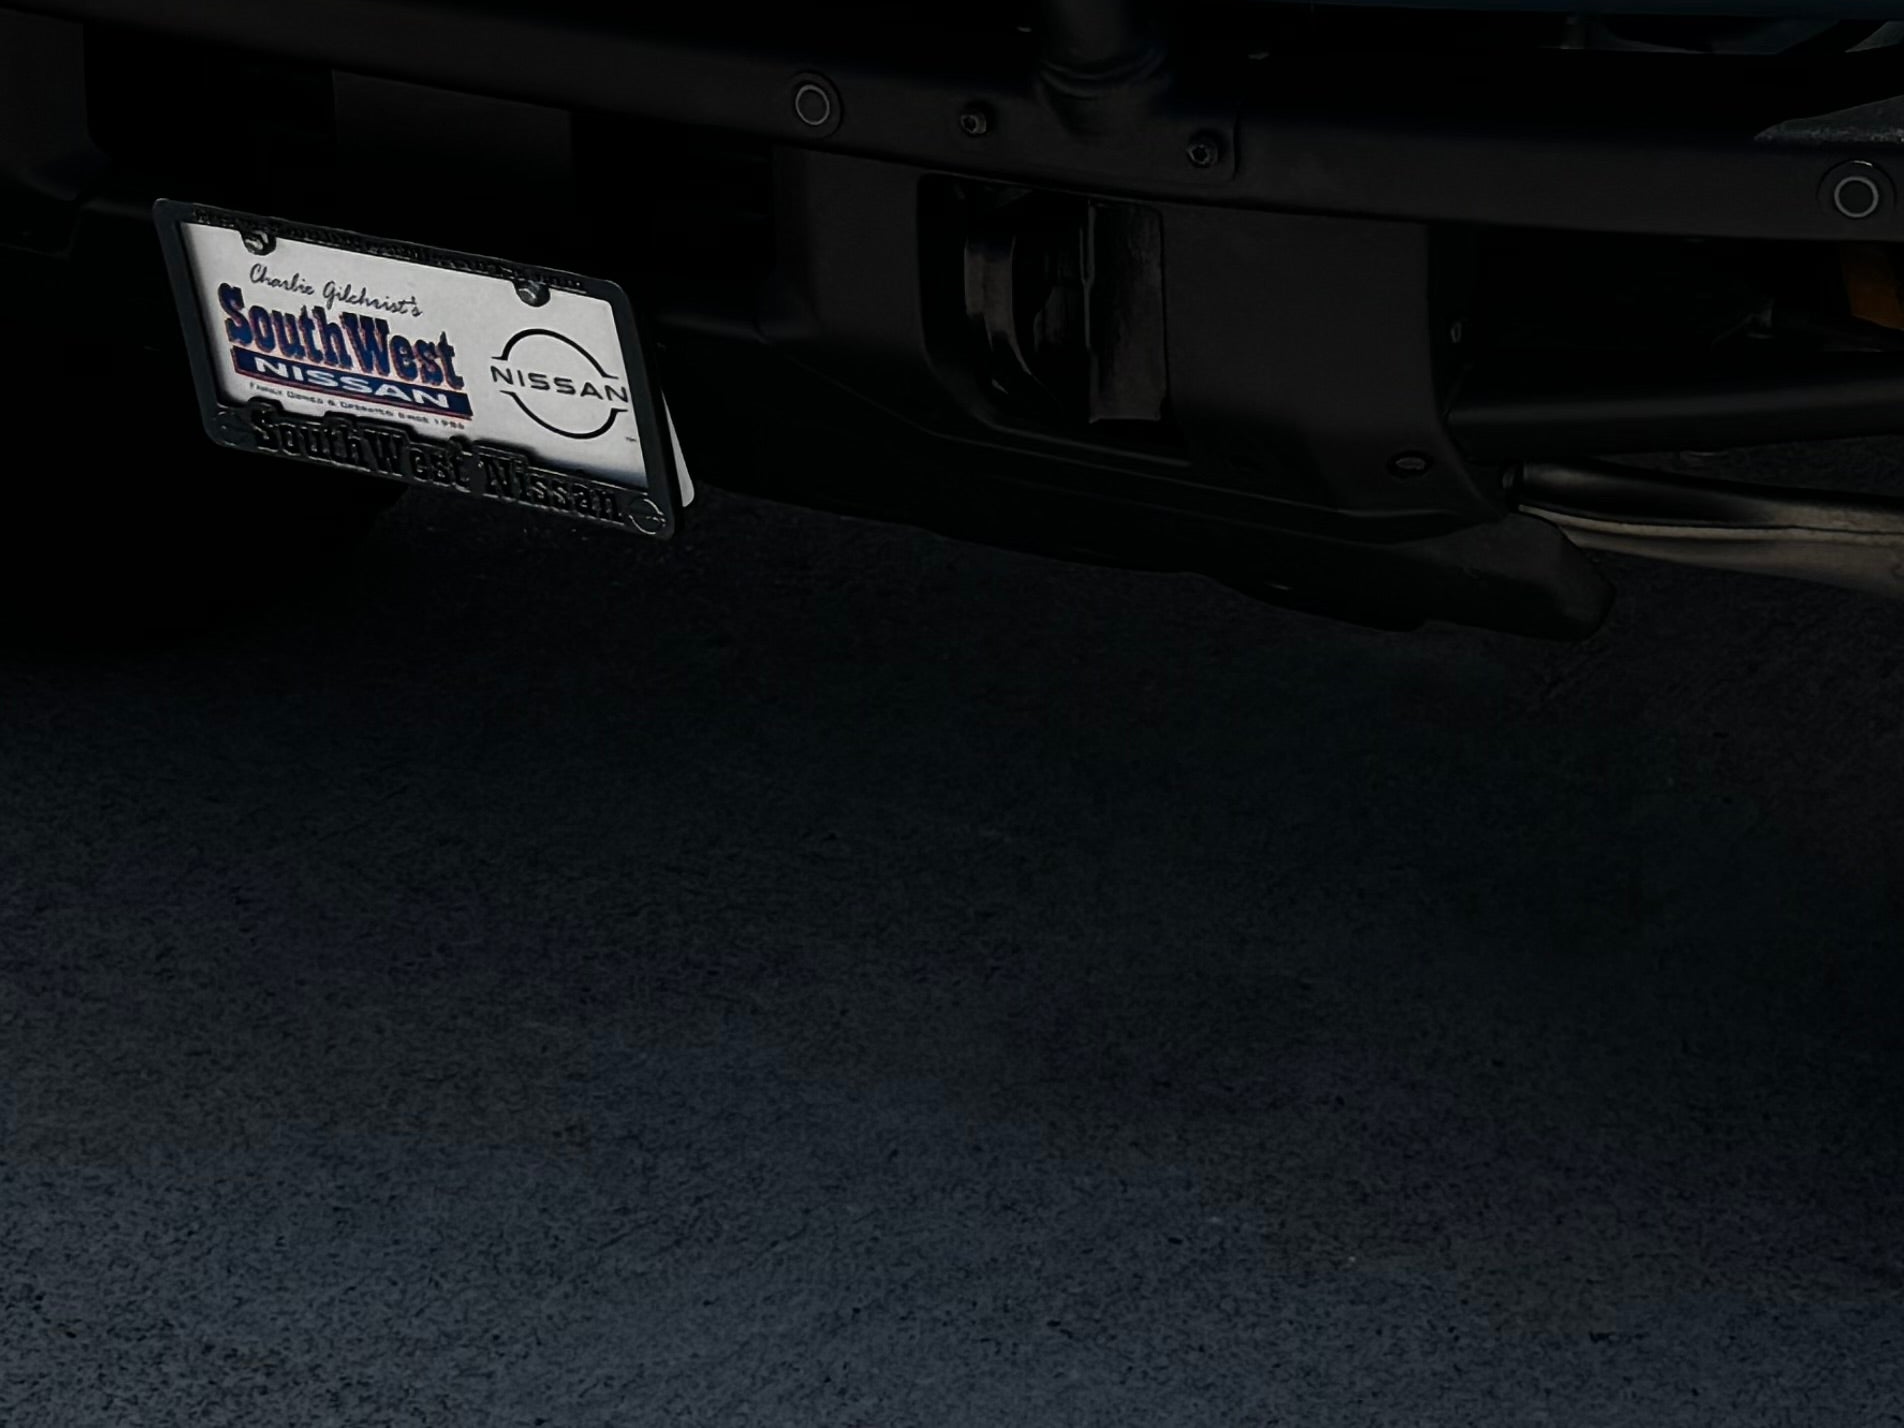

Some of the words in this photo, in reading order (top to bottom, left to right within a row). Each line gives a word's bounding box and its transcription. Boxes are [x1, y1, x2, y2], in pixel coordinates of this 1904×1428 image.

[249, 262, 315, 296] Charlie
[217, 282, 466, 391] SouthWest
[253, 356, 450, 409] NISSAN
[490, 365, 629, 403] NISSAN
[477, 443, 625, 525] Nissan
